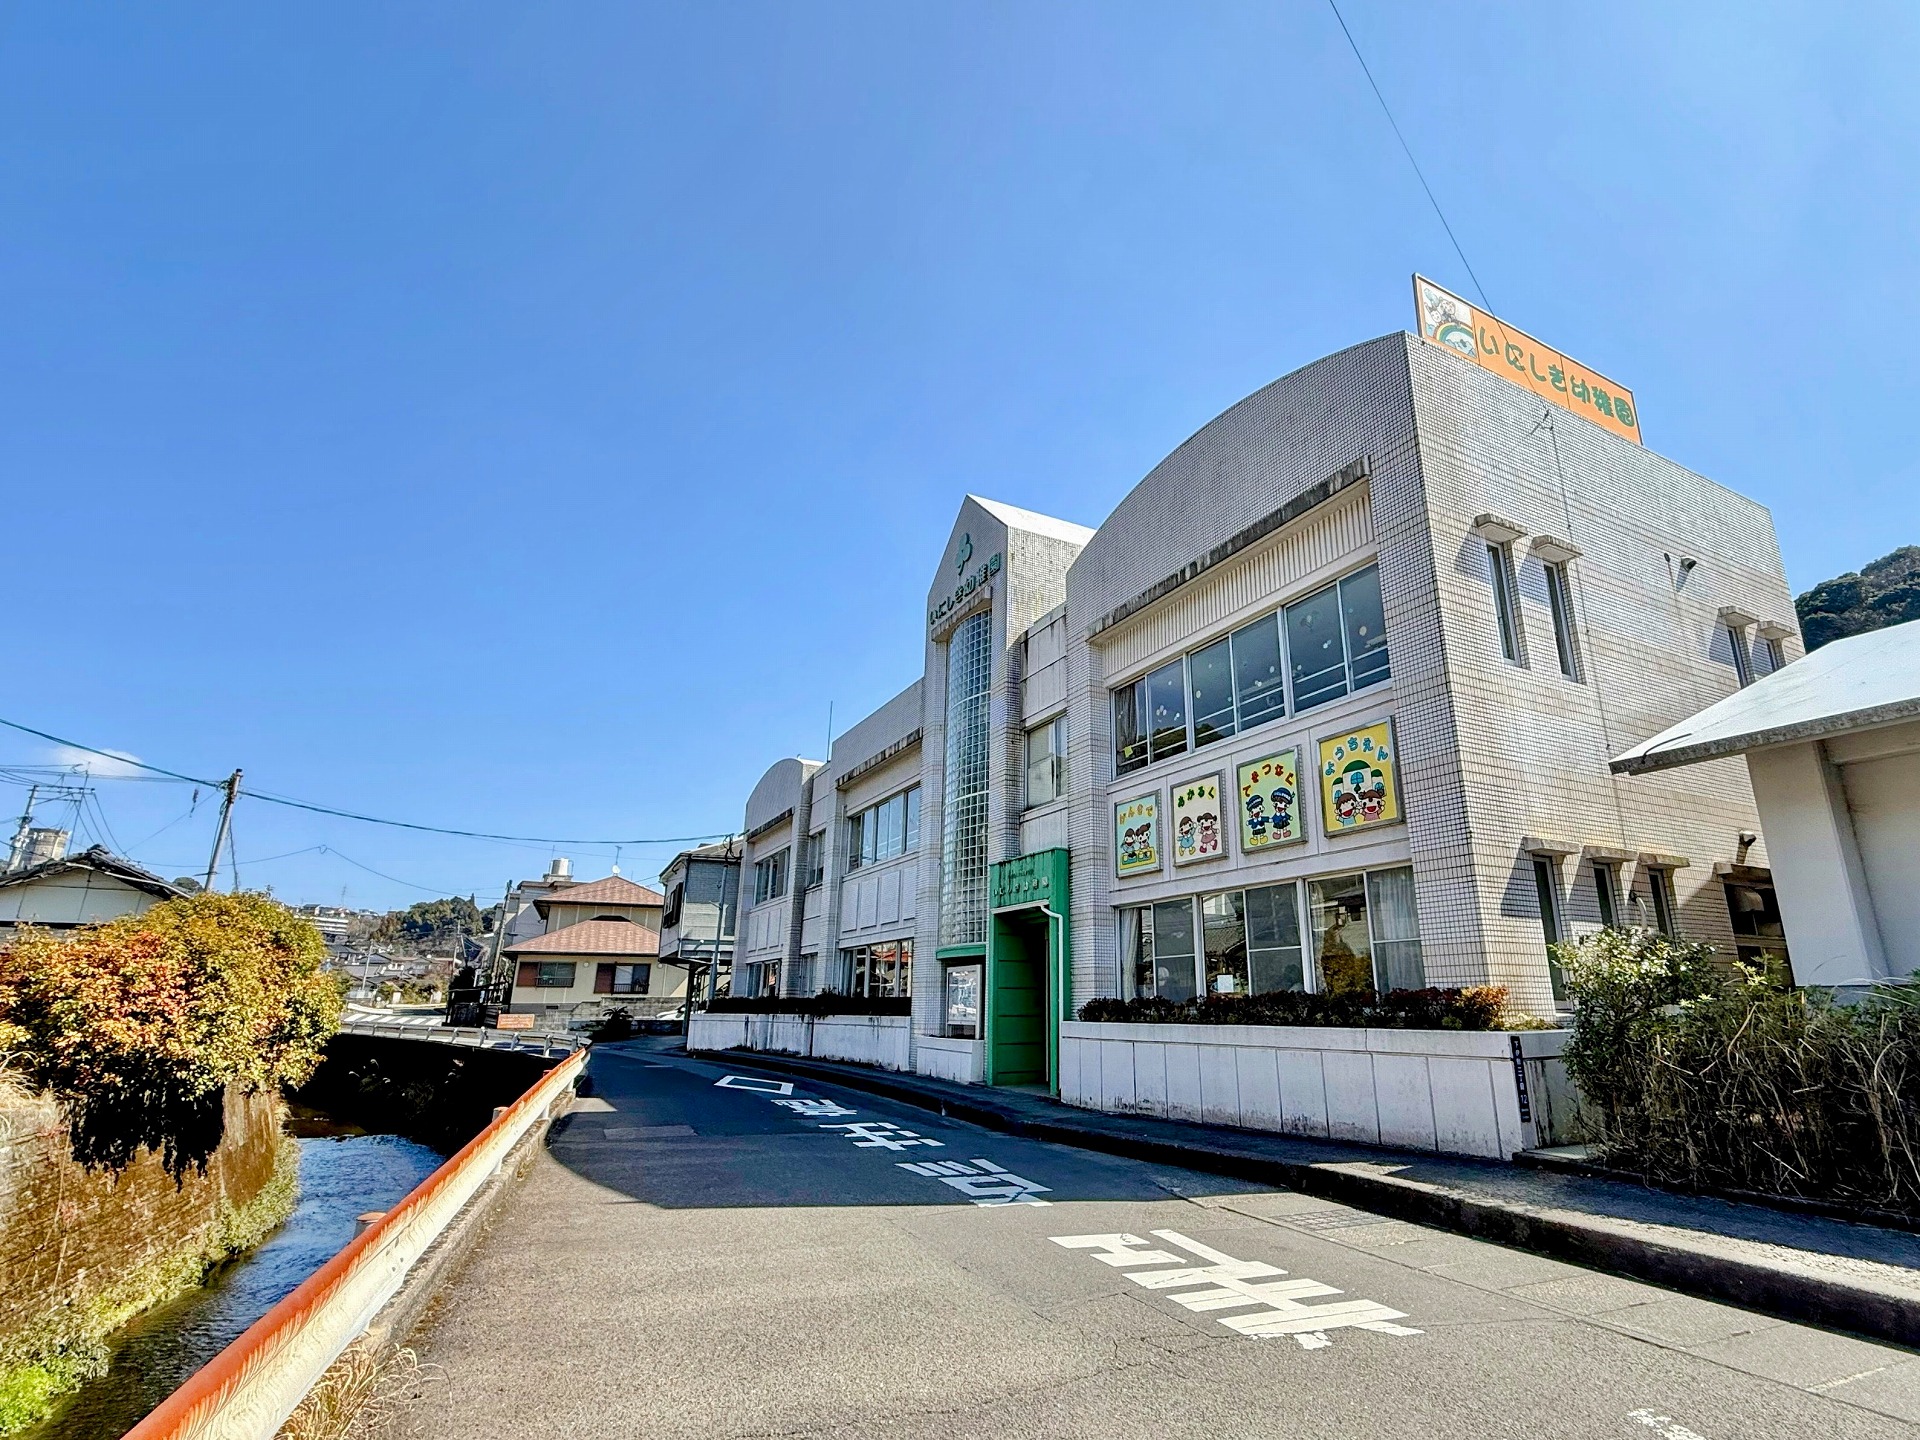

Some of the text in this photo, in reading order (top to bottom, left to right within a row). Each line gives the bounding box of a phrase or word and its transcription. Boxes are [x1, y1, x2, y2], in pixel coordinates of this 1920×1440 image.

[1479, 326, 1635, 428] いにしき幼稚園
[930, 553, 1001, 625] いにしき幼稚園
[1325, 736, 1389, 776] ようちえん
[1177, 785, 1215, 808] あかるく
